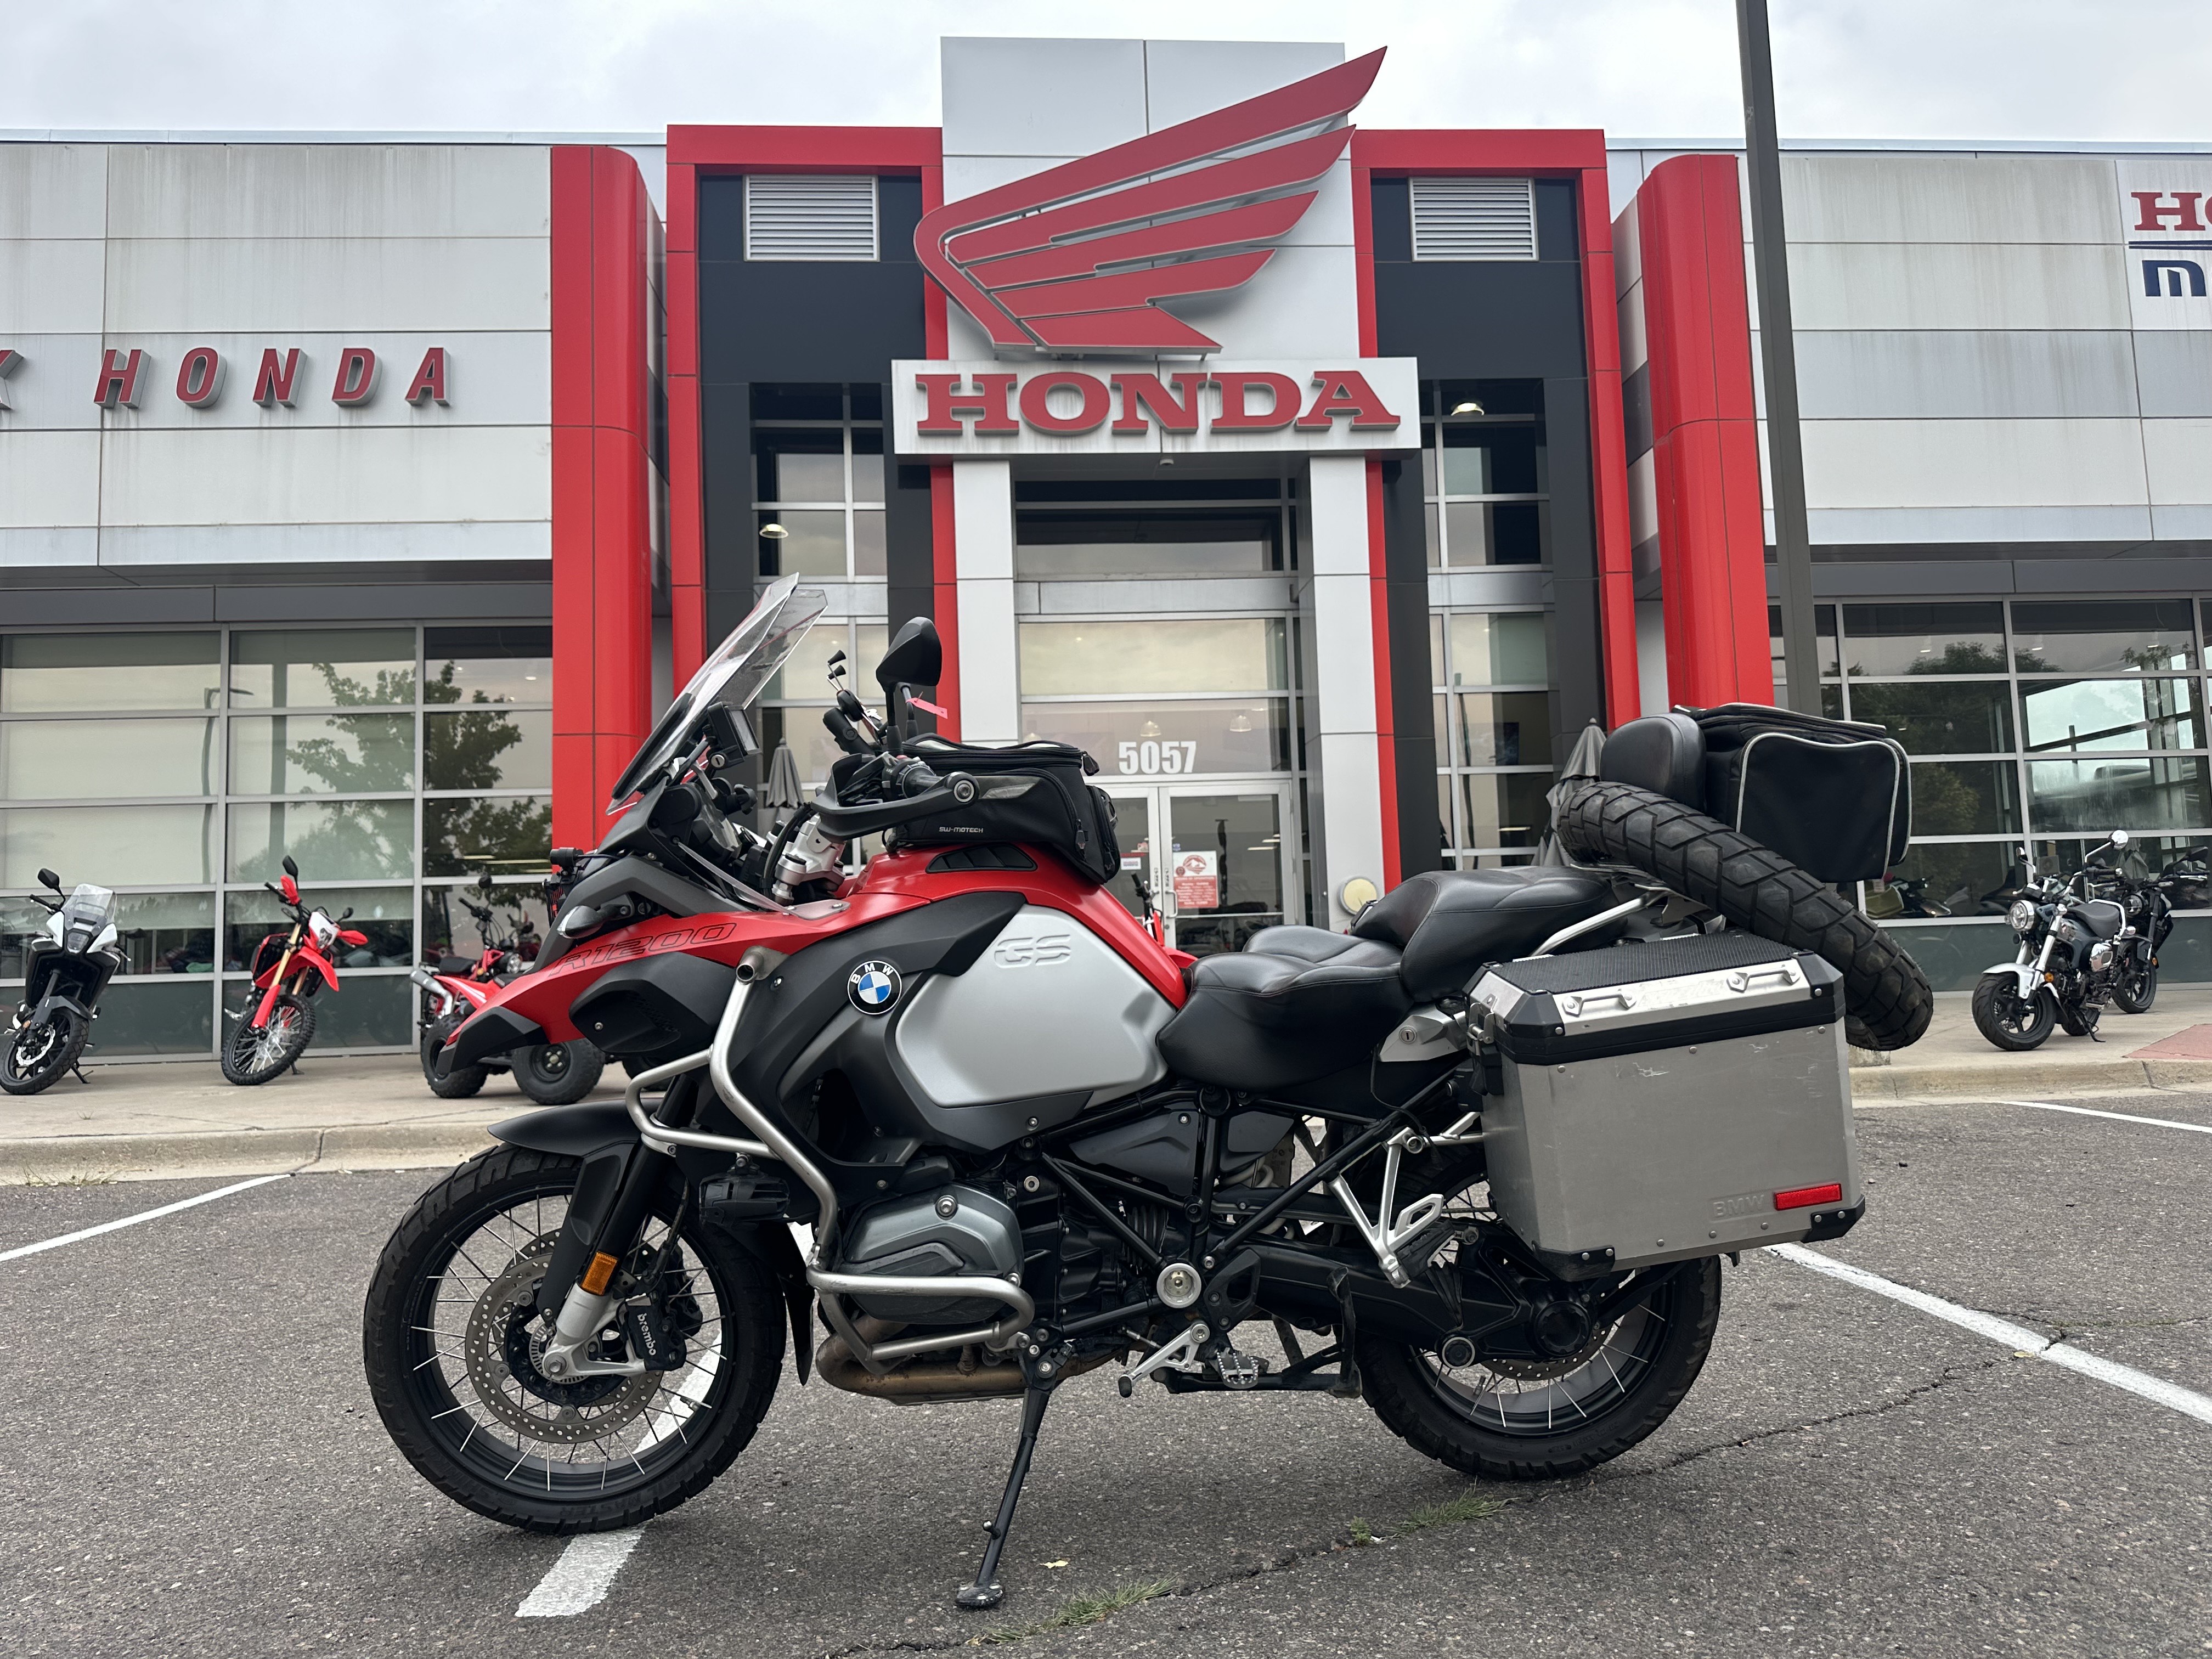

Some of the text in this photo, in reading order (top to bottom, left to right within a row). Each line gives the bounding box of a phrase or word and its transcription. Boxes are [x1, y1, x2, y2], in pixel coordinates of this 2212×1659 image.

[2131, 192, 2212, 231] H
[2142, 259, 2212, 297] m
[94, 347, 451, 409] HONDA
[915, 371, 1401, 435] HONDA
[1118, 741, 1197, 775] 5057
[548, 922, 737, 977] R1200
[994, 934, 1071, 969] GS
[850, 962, 893, 985] BMW
[1712, 1194, 1764, 1218] BMW
[637, 1313, 657, 1356] brembo
